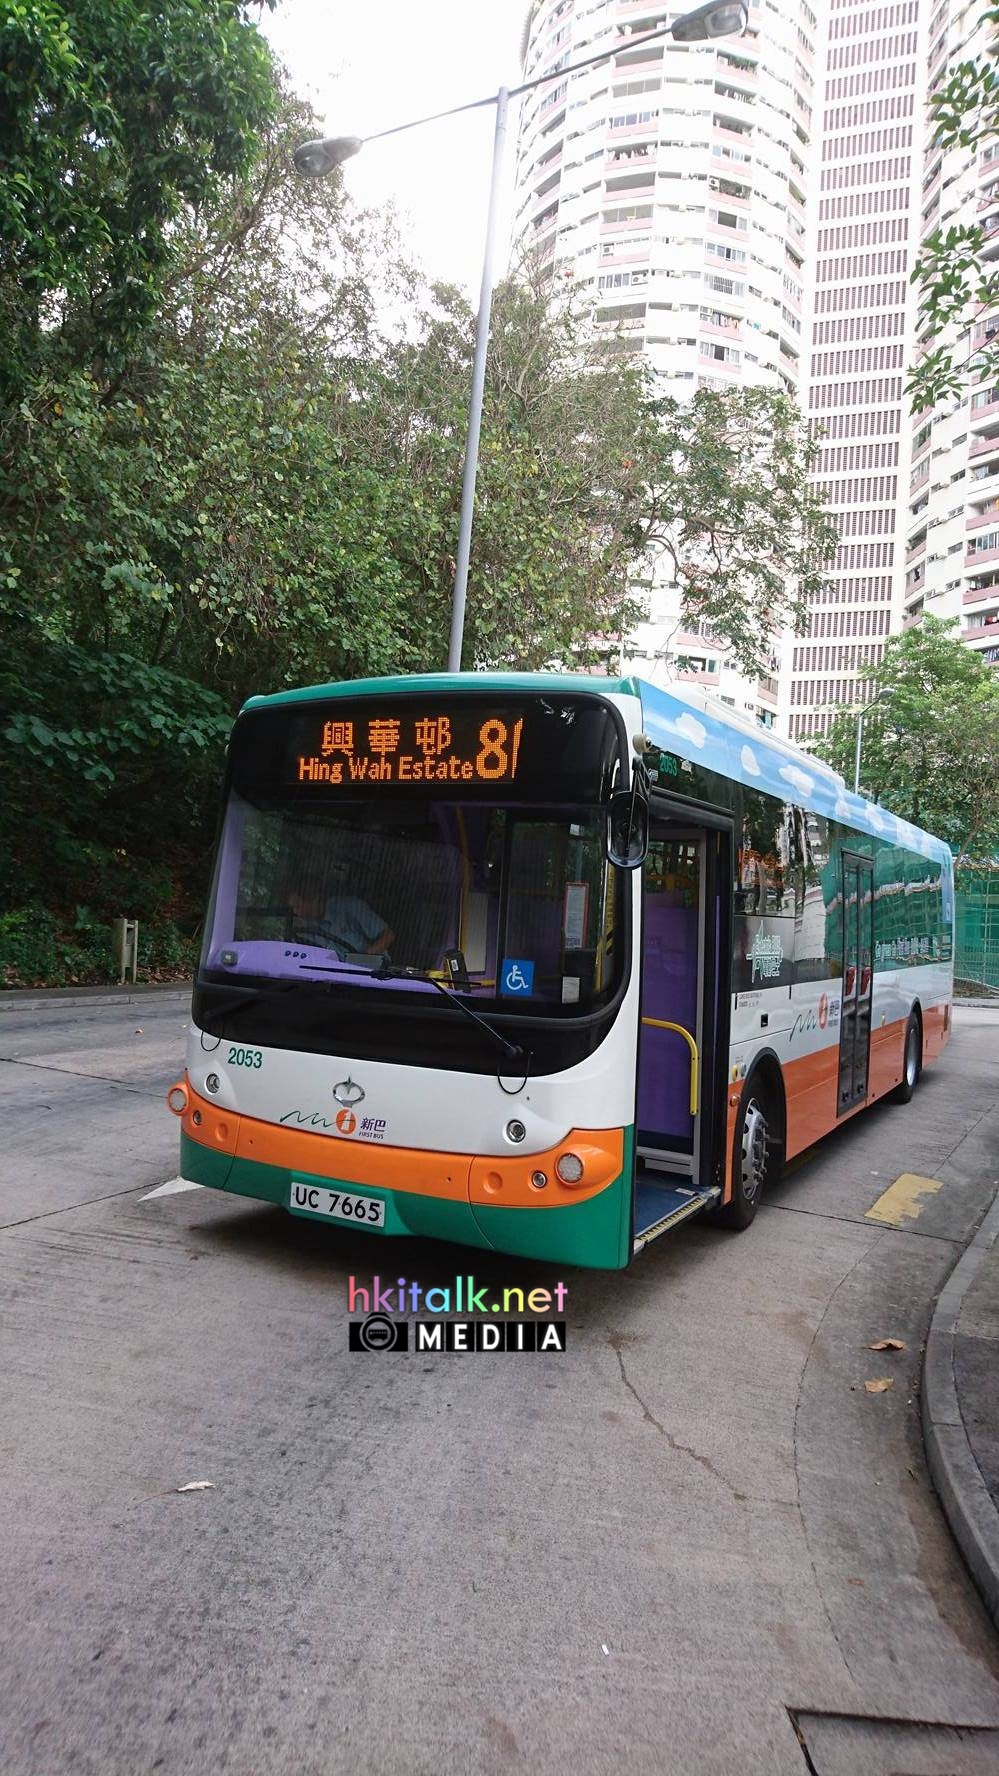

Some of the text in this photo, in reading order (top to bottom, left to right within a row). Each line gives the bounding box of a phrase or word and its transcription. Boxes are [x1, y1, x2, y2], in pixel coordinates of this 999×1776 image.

[321, 717, 452, 756] 興華邨
[476, 717, 523, 779] 81
[299, 755, 473, 784] Hing Wah Estate
[227, 1047, 263, 1069] 2053
[359, 1131, 384, 1140] FIRST BUS
[360, 1117, 386, 1132] 新巴
[295, 1186, 380, 1222] UC 7665
